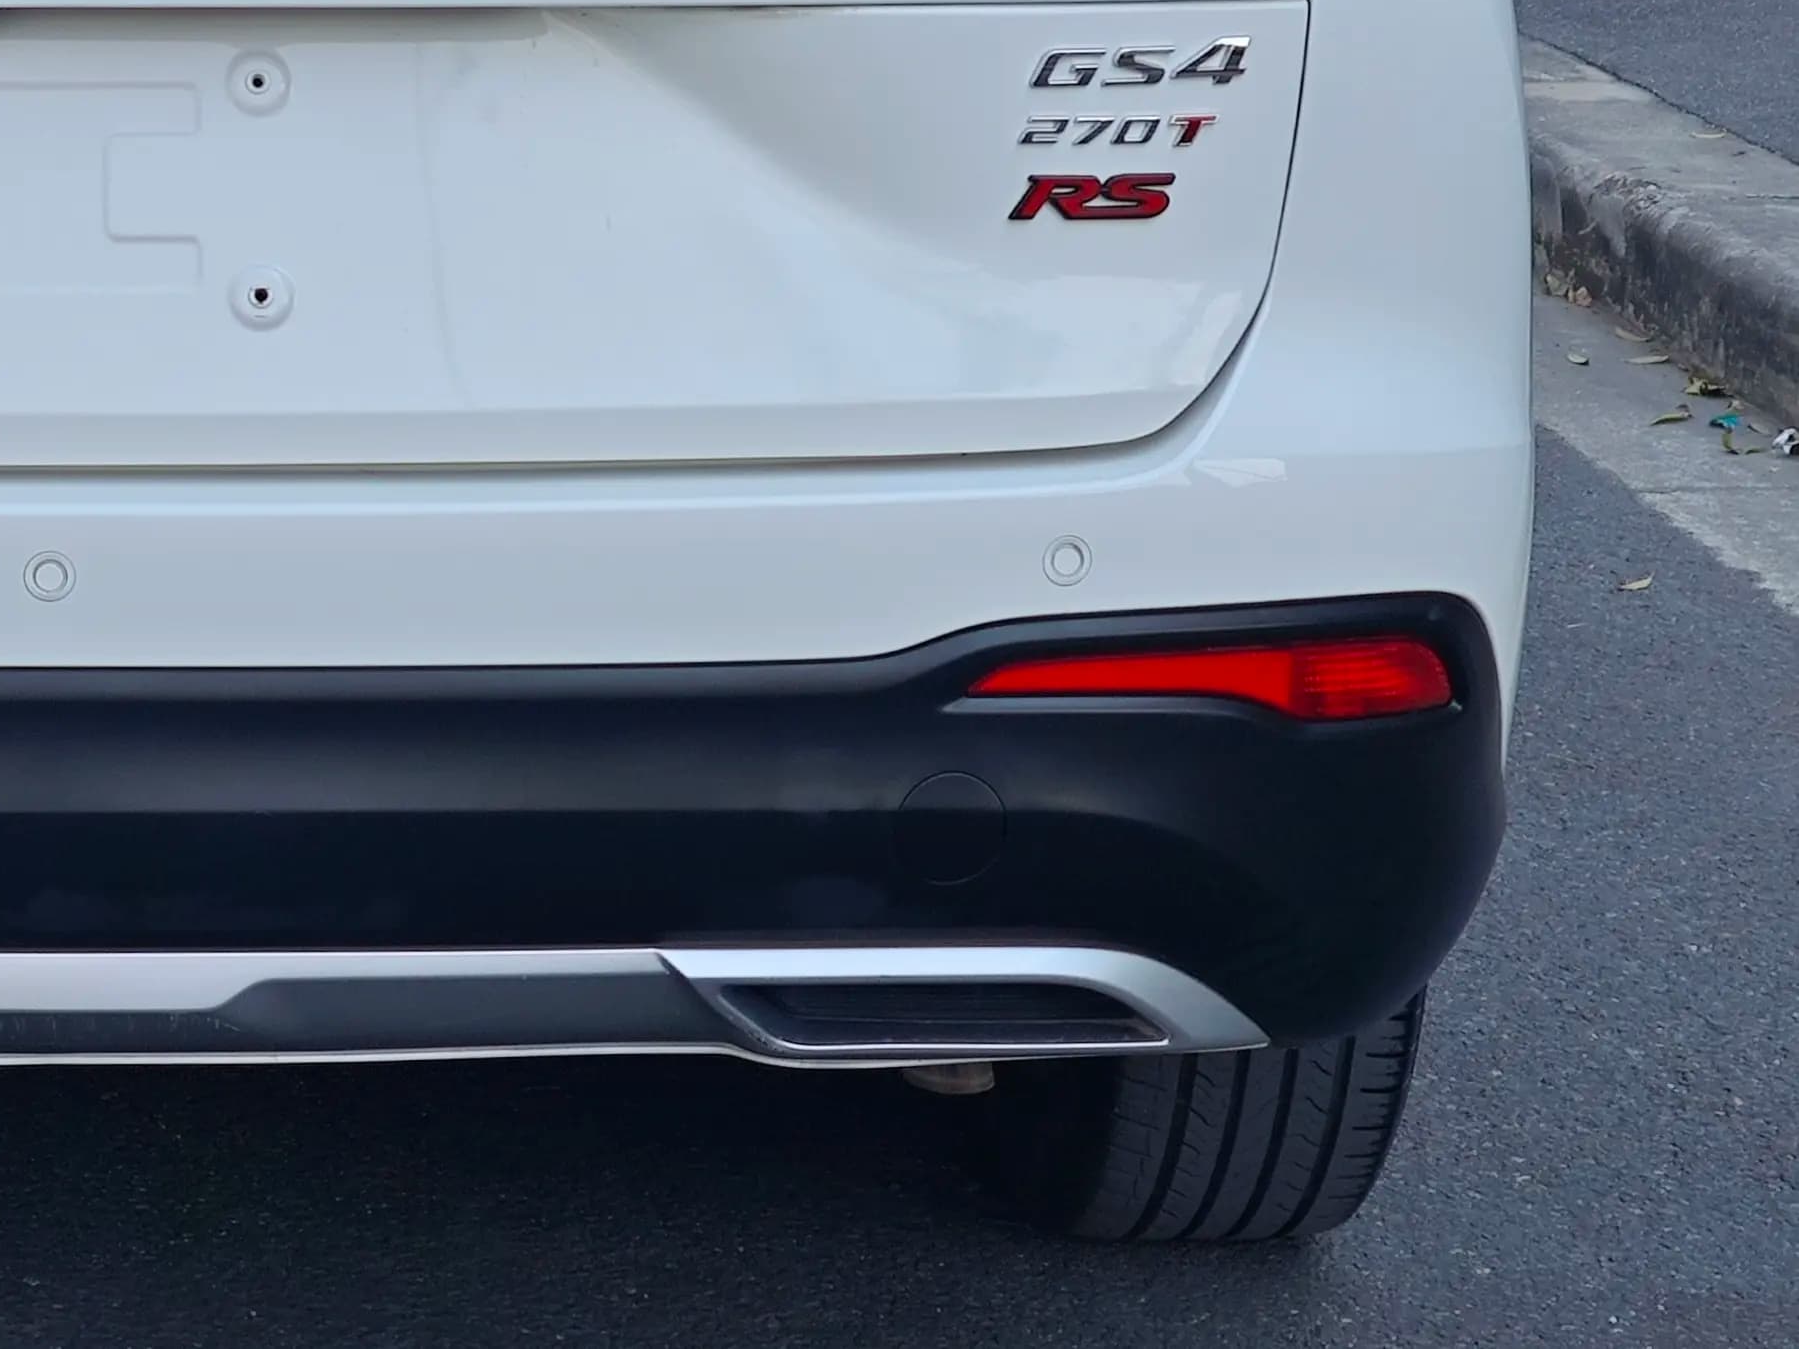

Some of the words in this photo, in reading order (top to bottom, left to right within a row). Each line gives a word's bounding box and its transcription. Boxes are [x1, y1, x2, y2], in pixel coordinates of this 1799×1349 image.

[1029, 35, 1252, 88] GS4
[1017, 114, 1219, 148] 270T
[1008, 172, 1176, 220] RS
